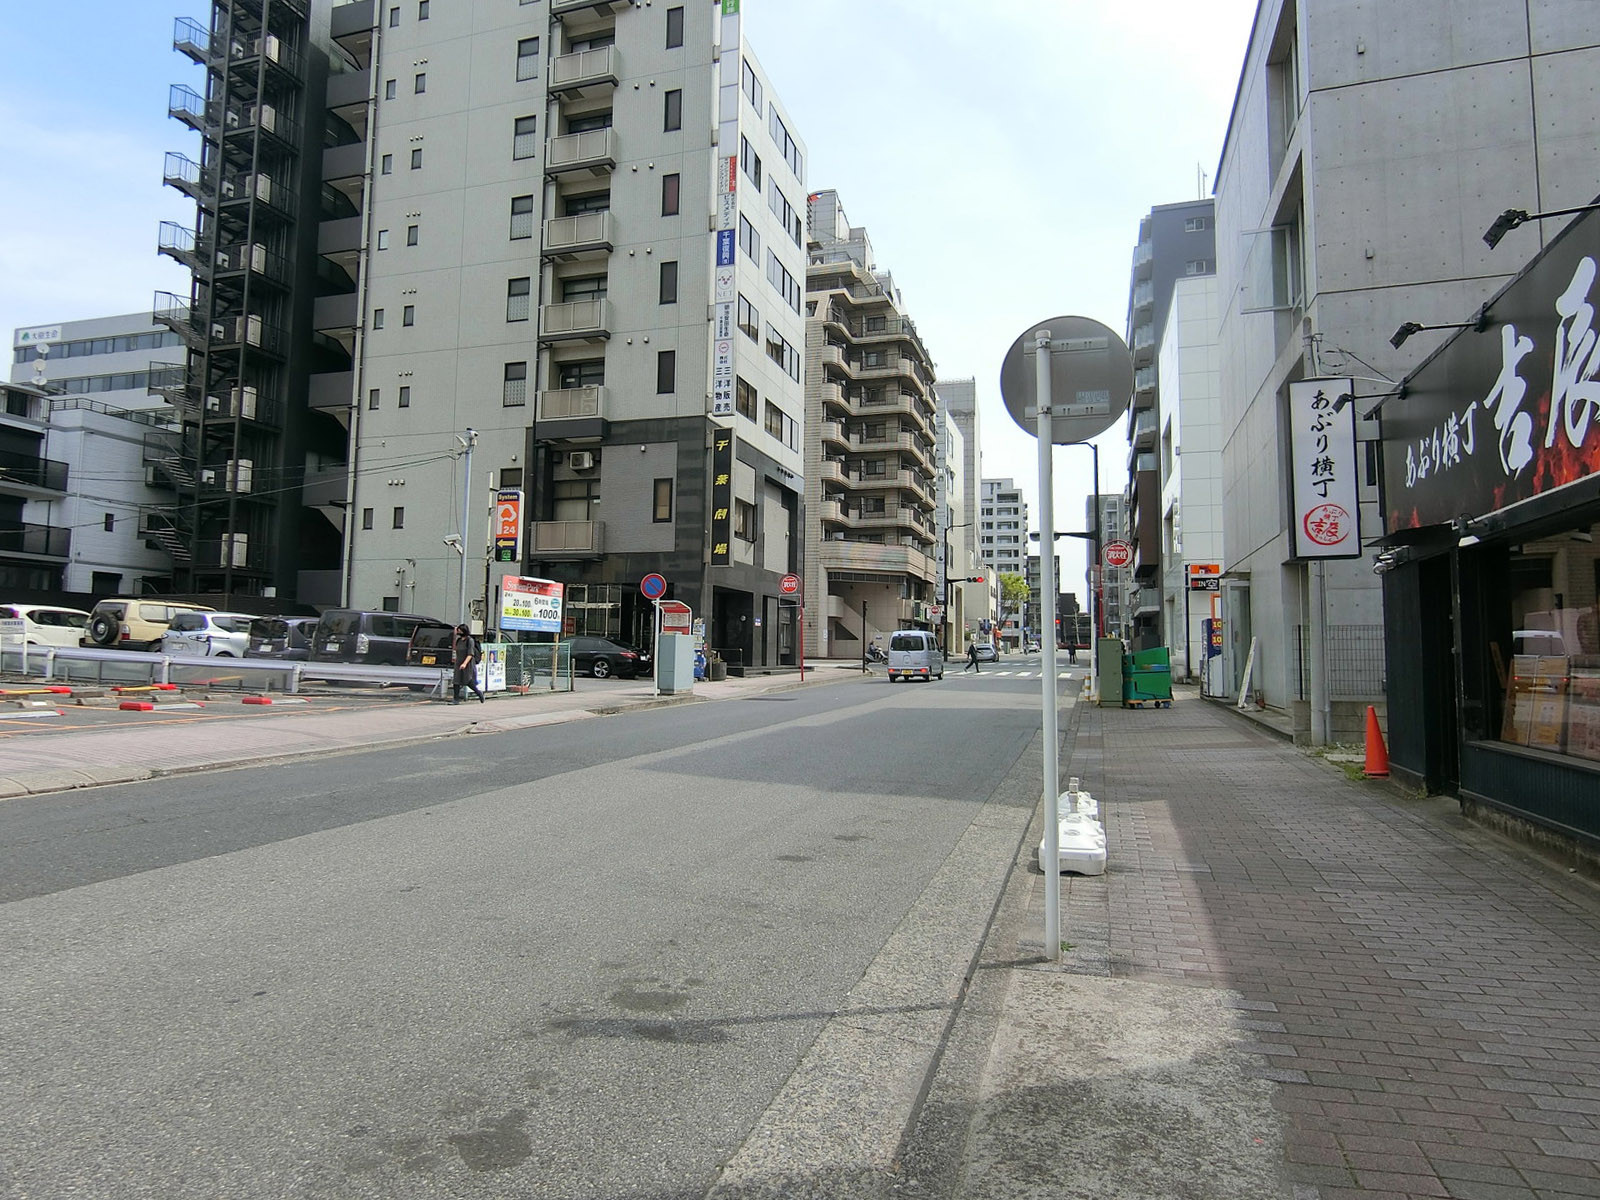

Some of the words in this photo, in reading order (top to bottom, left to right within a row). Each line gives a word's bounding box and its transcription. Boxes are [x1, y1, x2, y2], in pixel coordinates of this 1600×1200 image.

[1311, 389, 1335, 498] あぶり横丁
[1405, 401, 1477, 488] あぶり横丁
[1107, 550, 1127, 559] 消火栓
